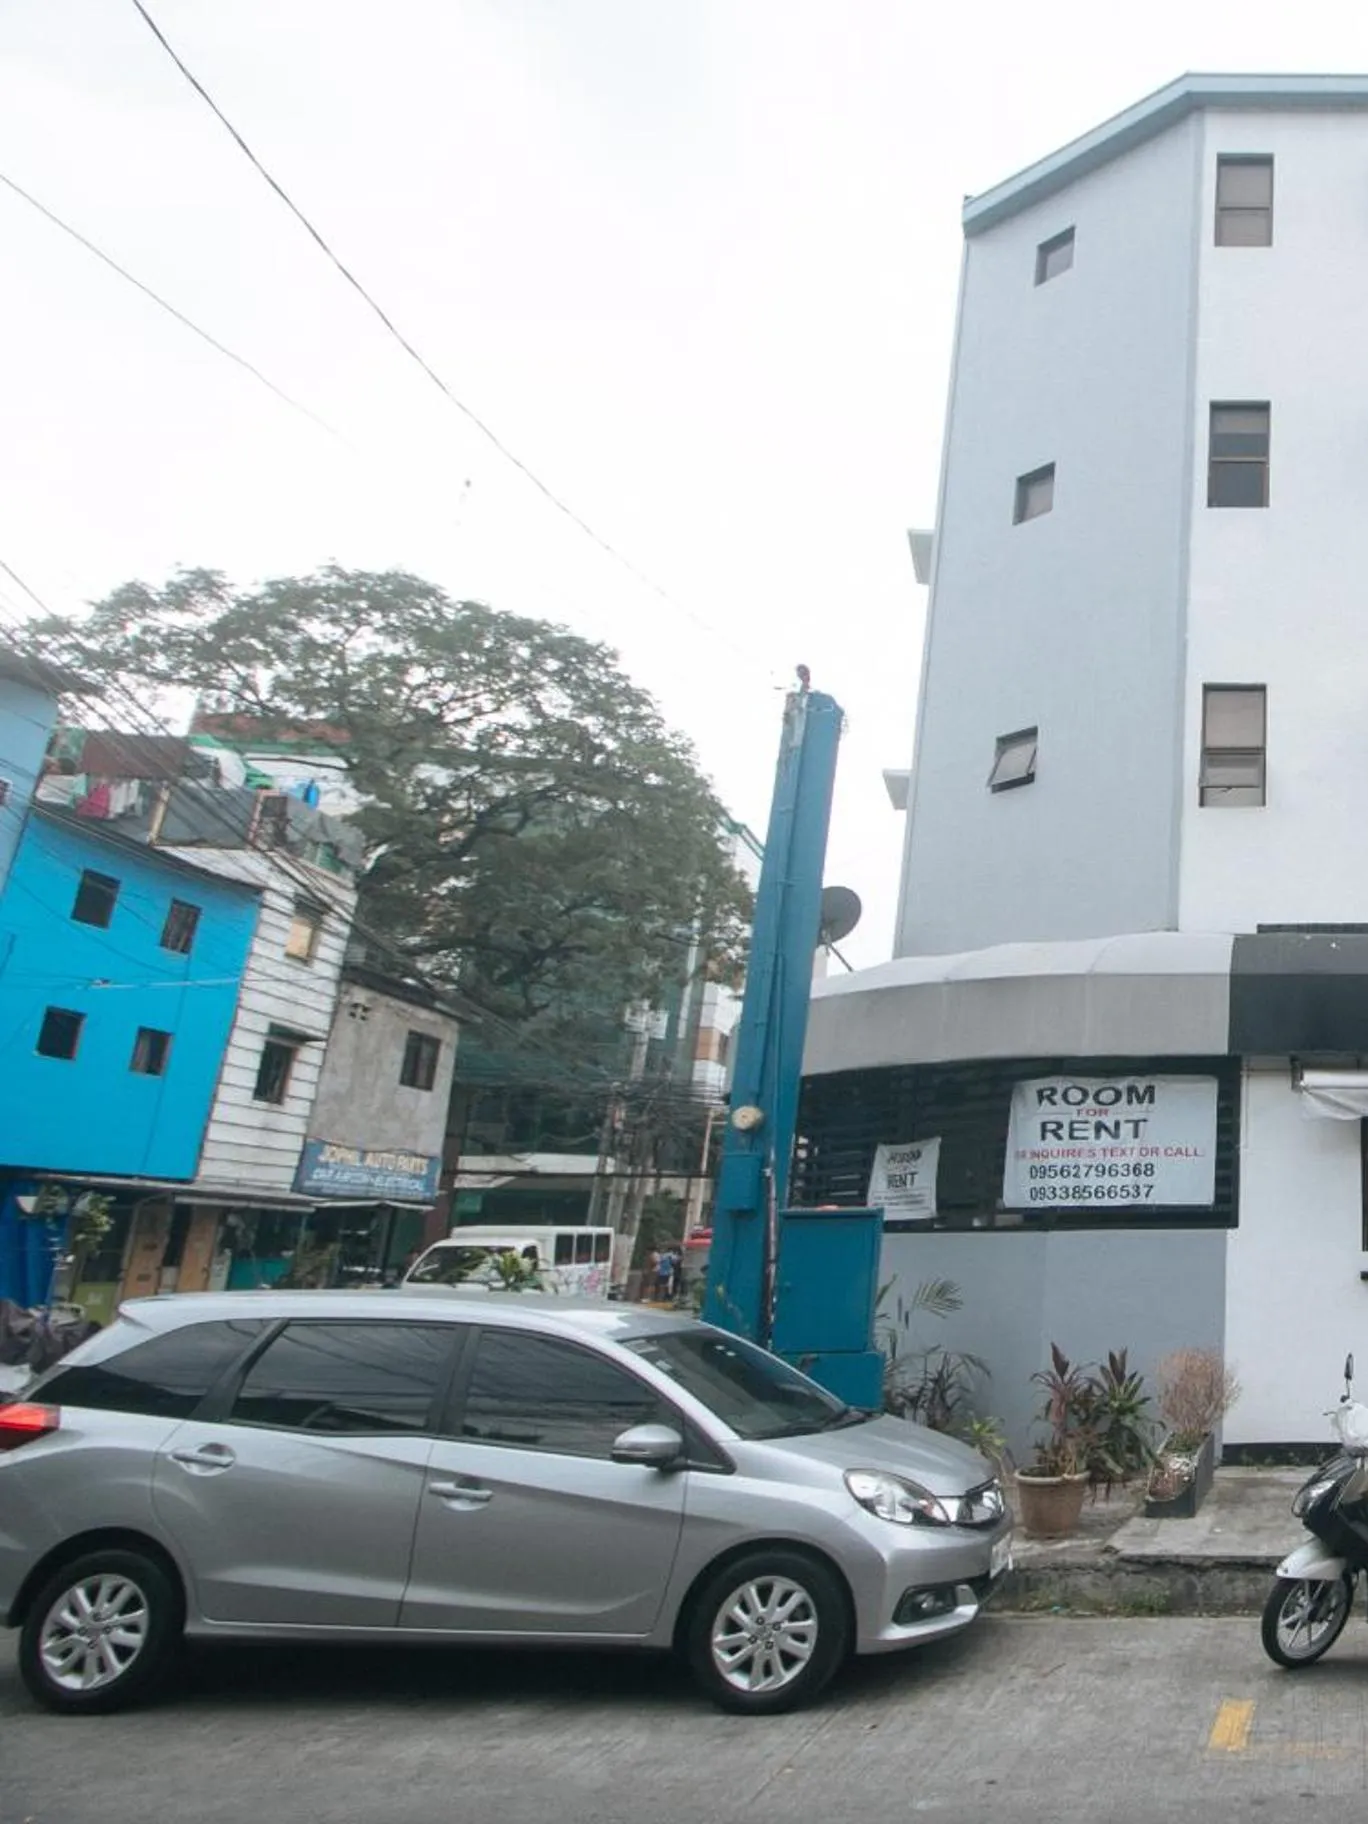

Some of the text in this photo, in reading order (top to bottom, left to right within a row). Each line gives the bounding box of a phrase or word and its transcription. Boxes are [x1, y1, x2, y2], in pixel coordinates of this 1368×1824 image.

[1036, 1084, 1155, 1106] ROOM
[1076, 1108, 1109, 1117] FOR
[1040, 1119, 1148, 1141] RENT
[1100, 1147, 1134, 1158] TEXT
[1139, 1146, 1160, 1158] OR
[1163, 1146, 1204, 1158] CALL
[887, 1171, 919, 1189] RENT
[1029, 1162, 1155, 1180] 09562796368
[1029, 1184, 1154, 1201] 09338566537
